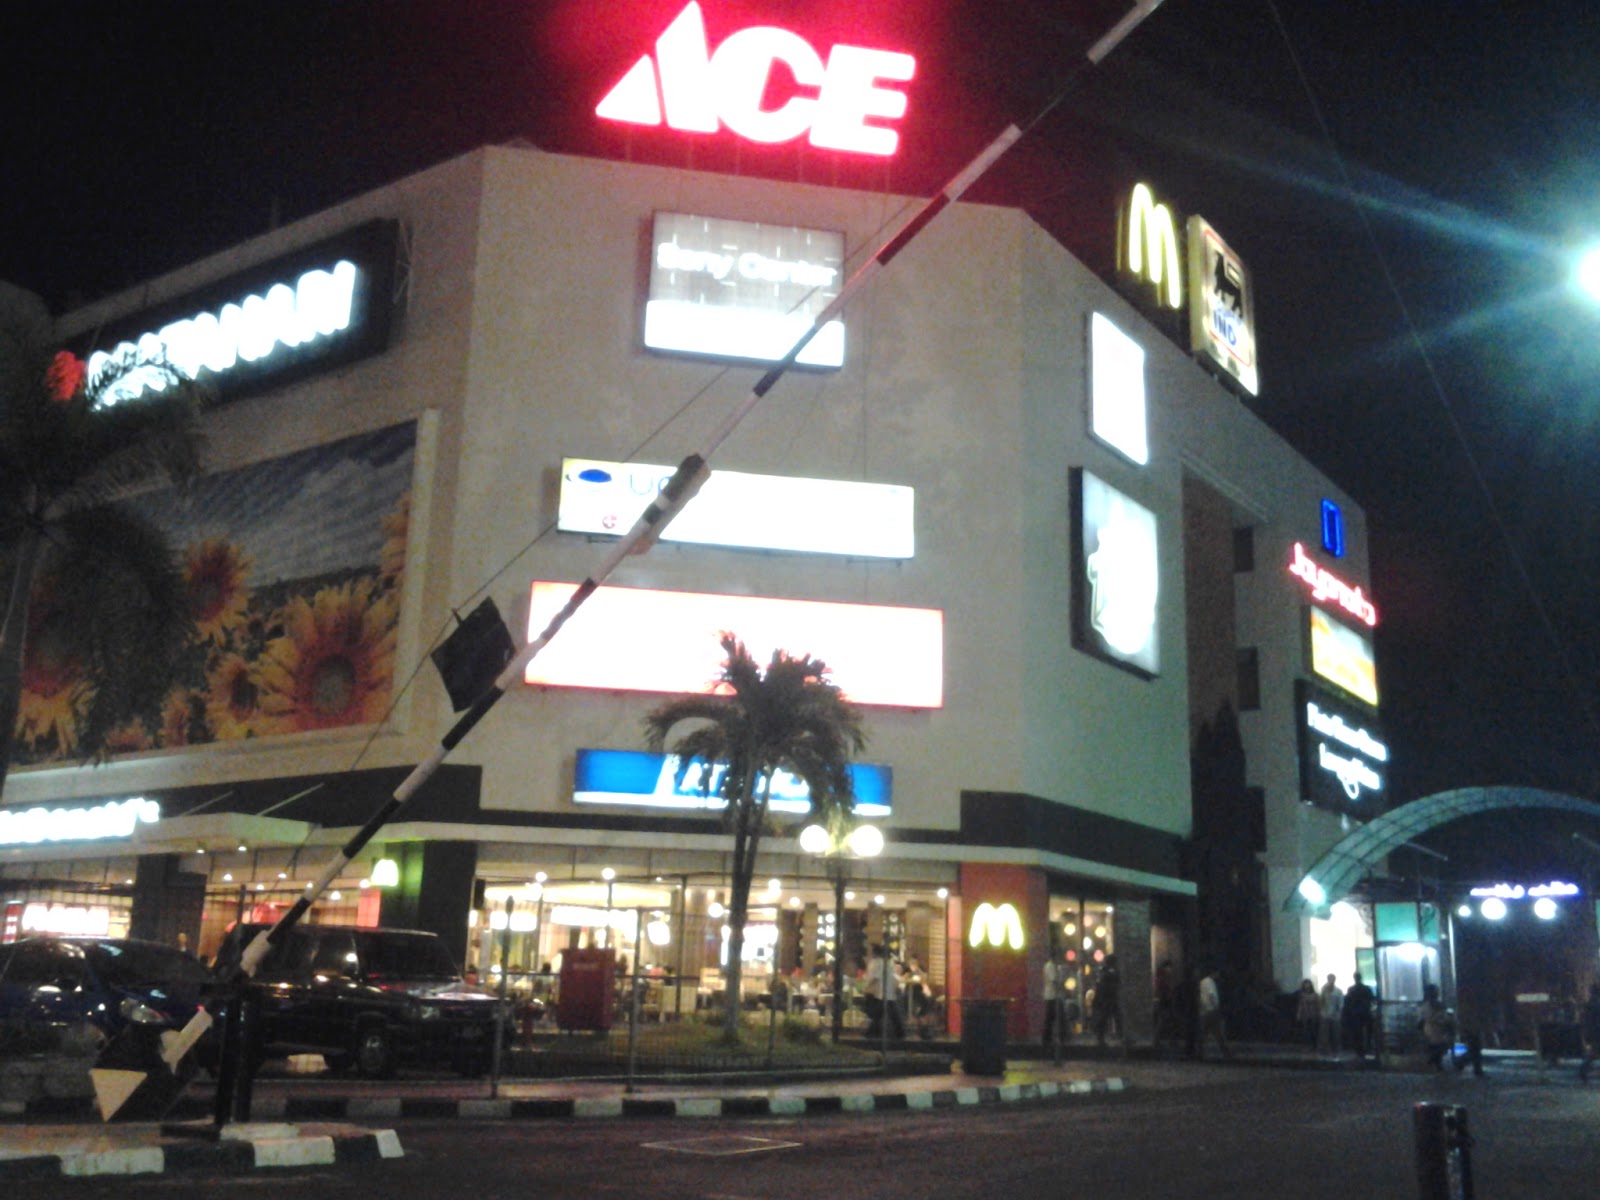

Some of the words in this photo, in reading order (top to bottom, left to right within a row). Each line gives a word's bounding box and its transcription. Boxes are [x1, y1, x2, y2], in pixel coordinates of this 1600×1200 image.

[596, 0, 916, 156] ACE
[656, 242, 735, 280] Sony
[738, 252, 838, 287] Center
[969, 902, 1025, 950] M
